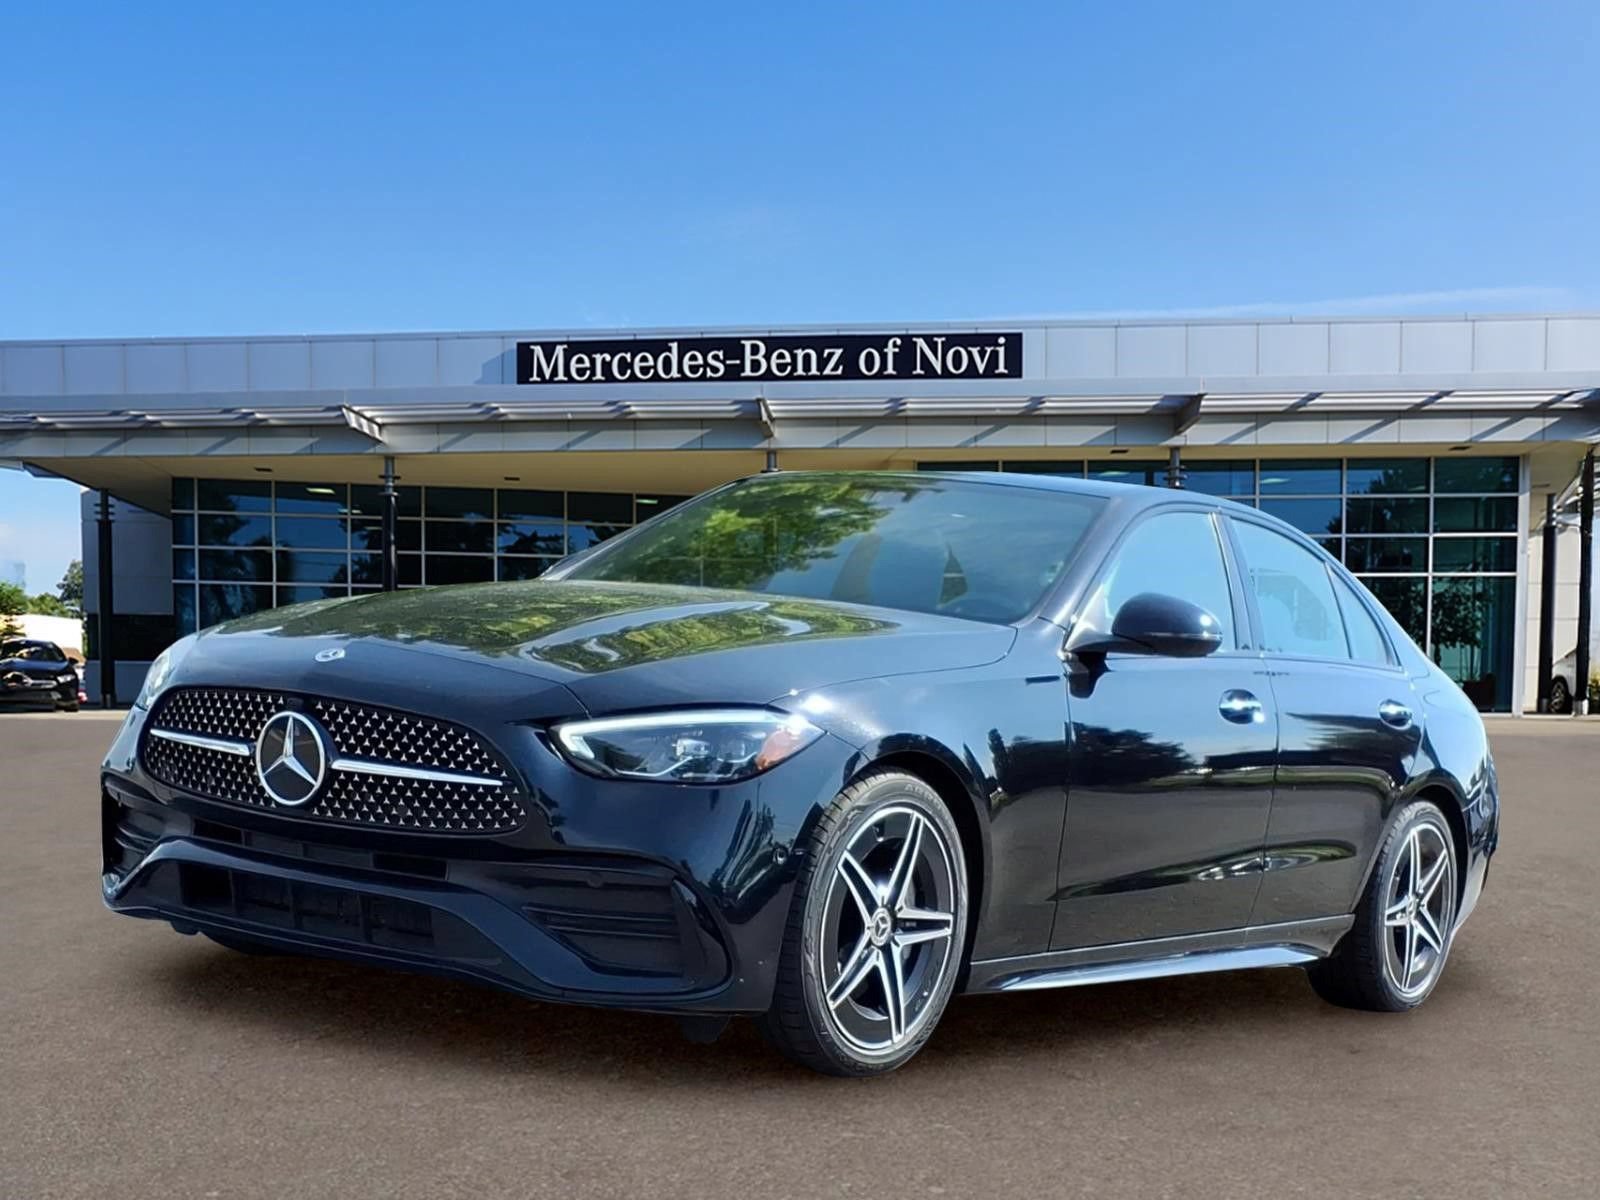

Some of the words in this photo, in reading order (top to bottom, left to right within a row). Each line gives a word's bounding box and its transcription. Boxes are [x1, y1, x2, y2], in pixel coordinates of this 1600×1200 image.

[529, 340, 844, 381] Mercedes-Benz
[858, 338, 902, 375] of
[912, 336, 1009, 375] Novi
